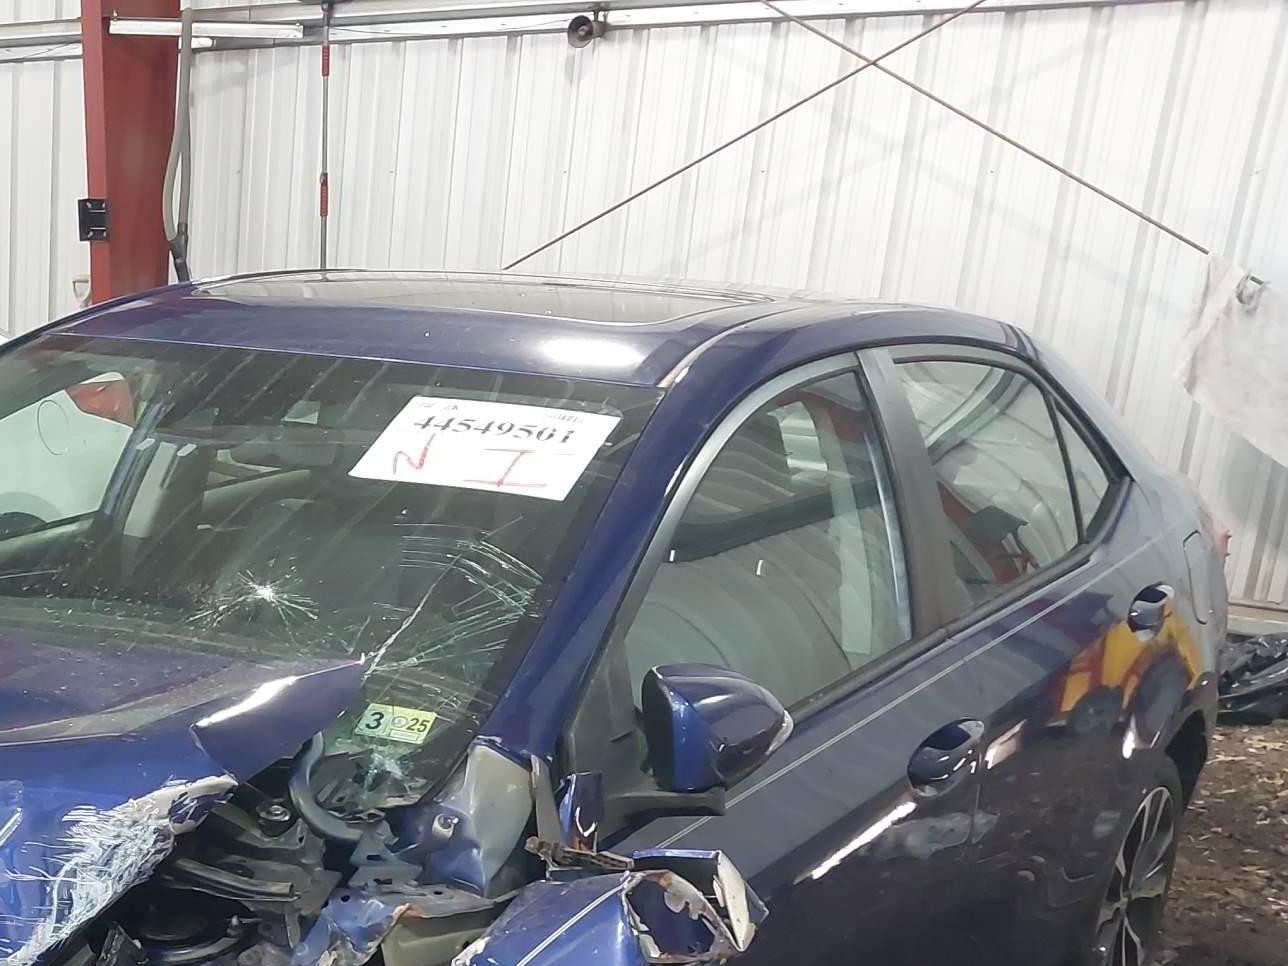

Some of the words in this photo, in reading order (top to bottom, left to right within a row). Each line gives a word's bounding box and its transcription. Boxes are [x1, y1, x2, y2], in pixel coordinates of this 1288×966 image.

[413, 415, 575, 443] 44549501
[366, 712, 384, 729] 3
[407, 718, 430, 732] 25
